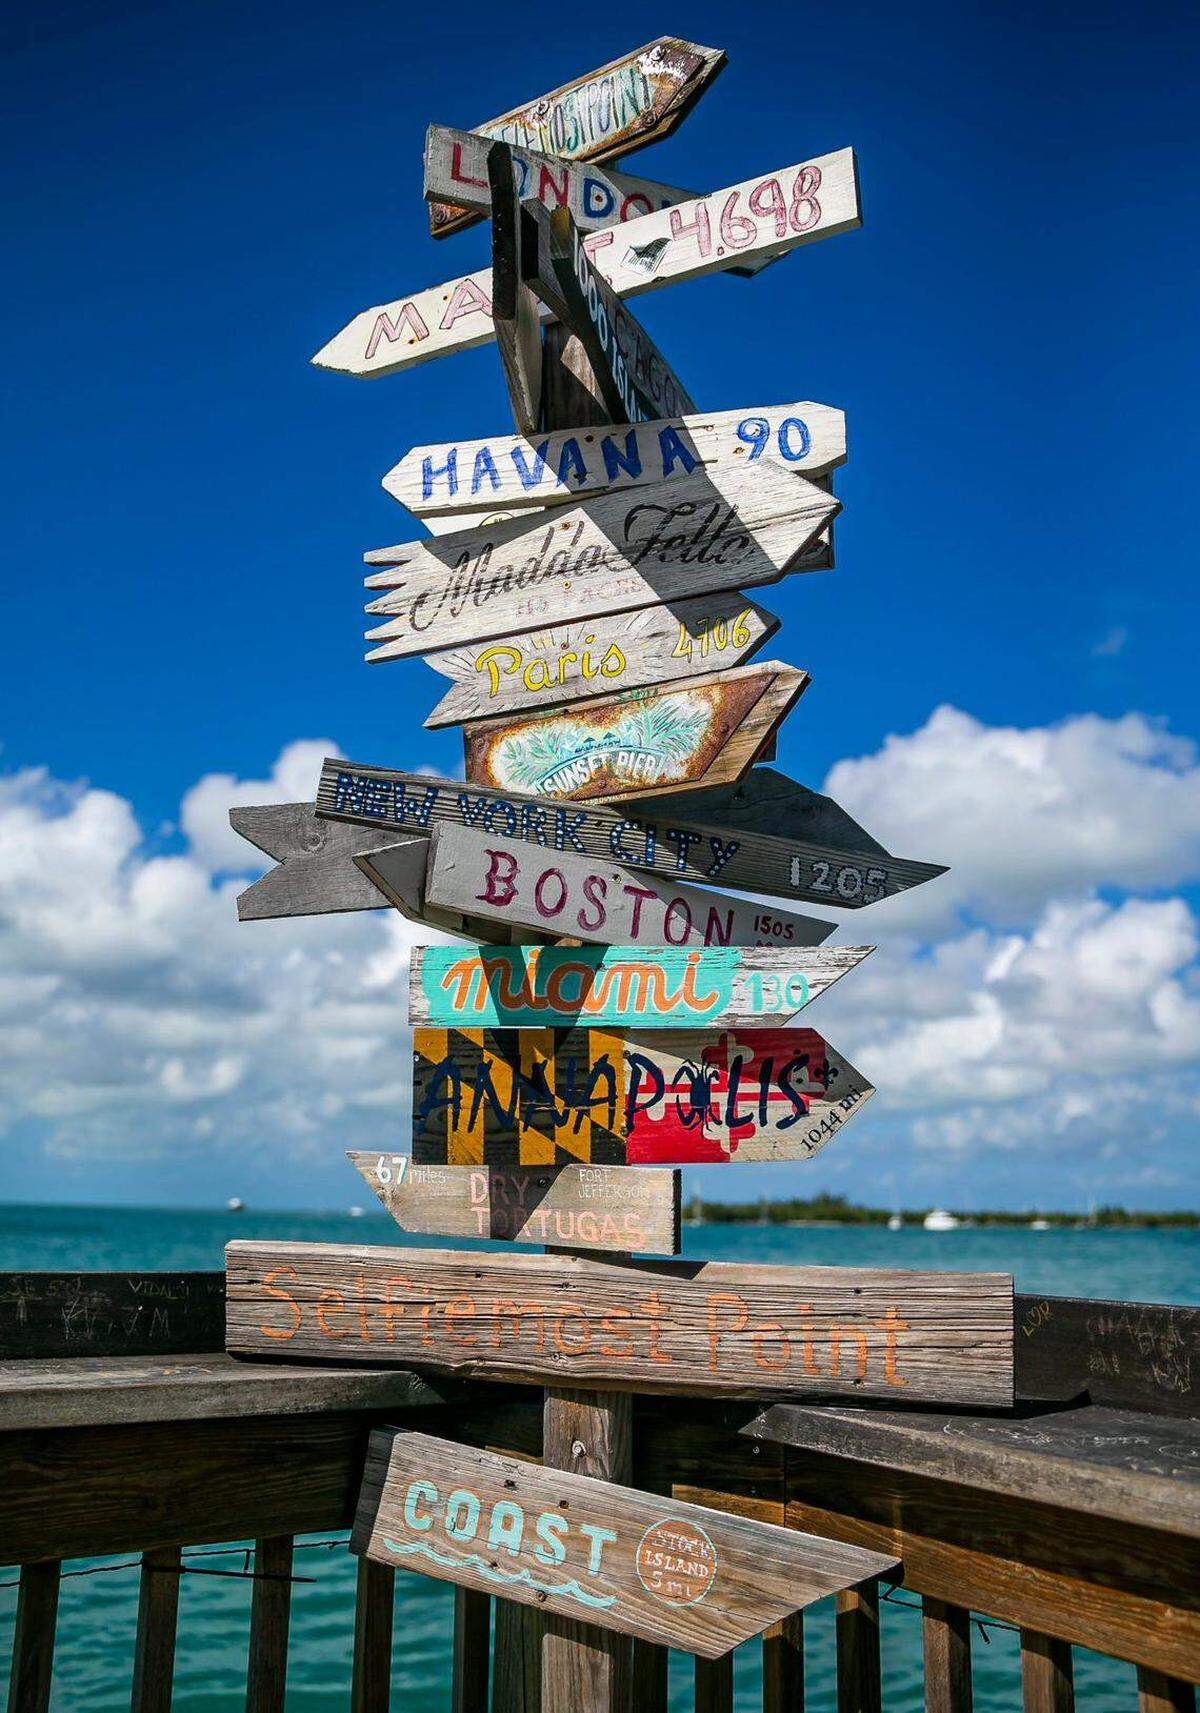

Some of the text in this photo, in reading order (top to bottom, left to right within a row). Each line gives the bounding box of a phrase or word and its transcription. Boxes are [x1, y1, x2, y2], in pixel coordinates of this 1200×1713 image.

[421, 417, 812, 502] HAVANA 90
[476, 608, 755, 699] Paris 4706
[543, 751, 659, 794] SUNSET PIER
[336, 772, 889, 906] NEW YORK CITY 1205
[474, 848, 735, 947] BOSTON
[753, 914, 795, 941] 1505
[440, 948, 810, 1014] miami 130
[800, 1109, 843, 1152] 1044
[376, 1155, 408, 1186] 67
[469, 1171, 530, 1206] DRY
[579, 1167, 612, 1183] FORT
[470, 1206, 647, 1250] TORTUGAS
[259, 1265, 911, 1388] Selfiemost Point
[403, 1479, 618, 1577] COAST
[645, 1549, 709, 1578] ISLAND
